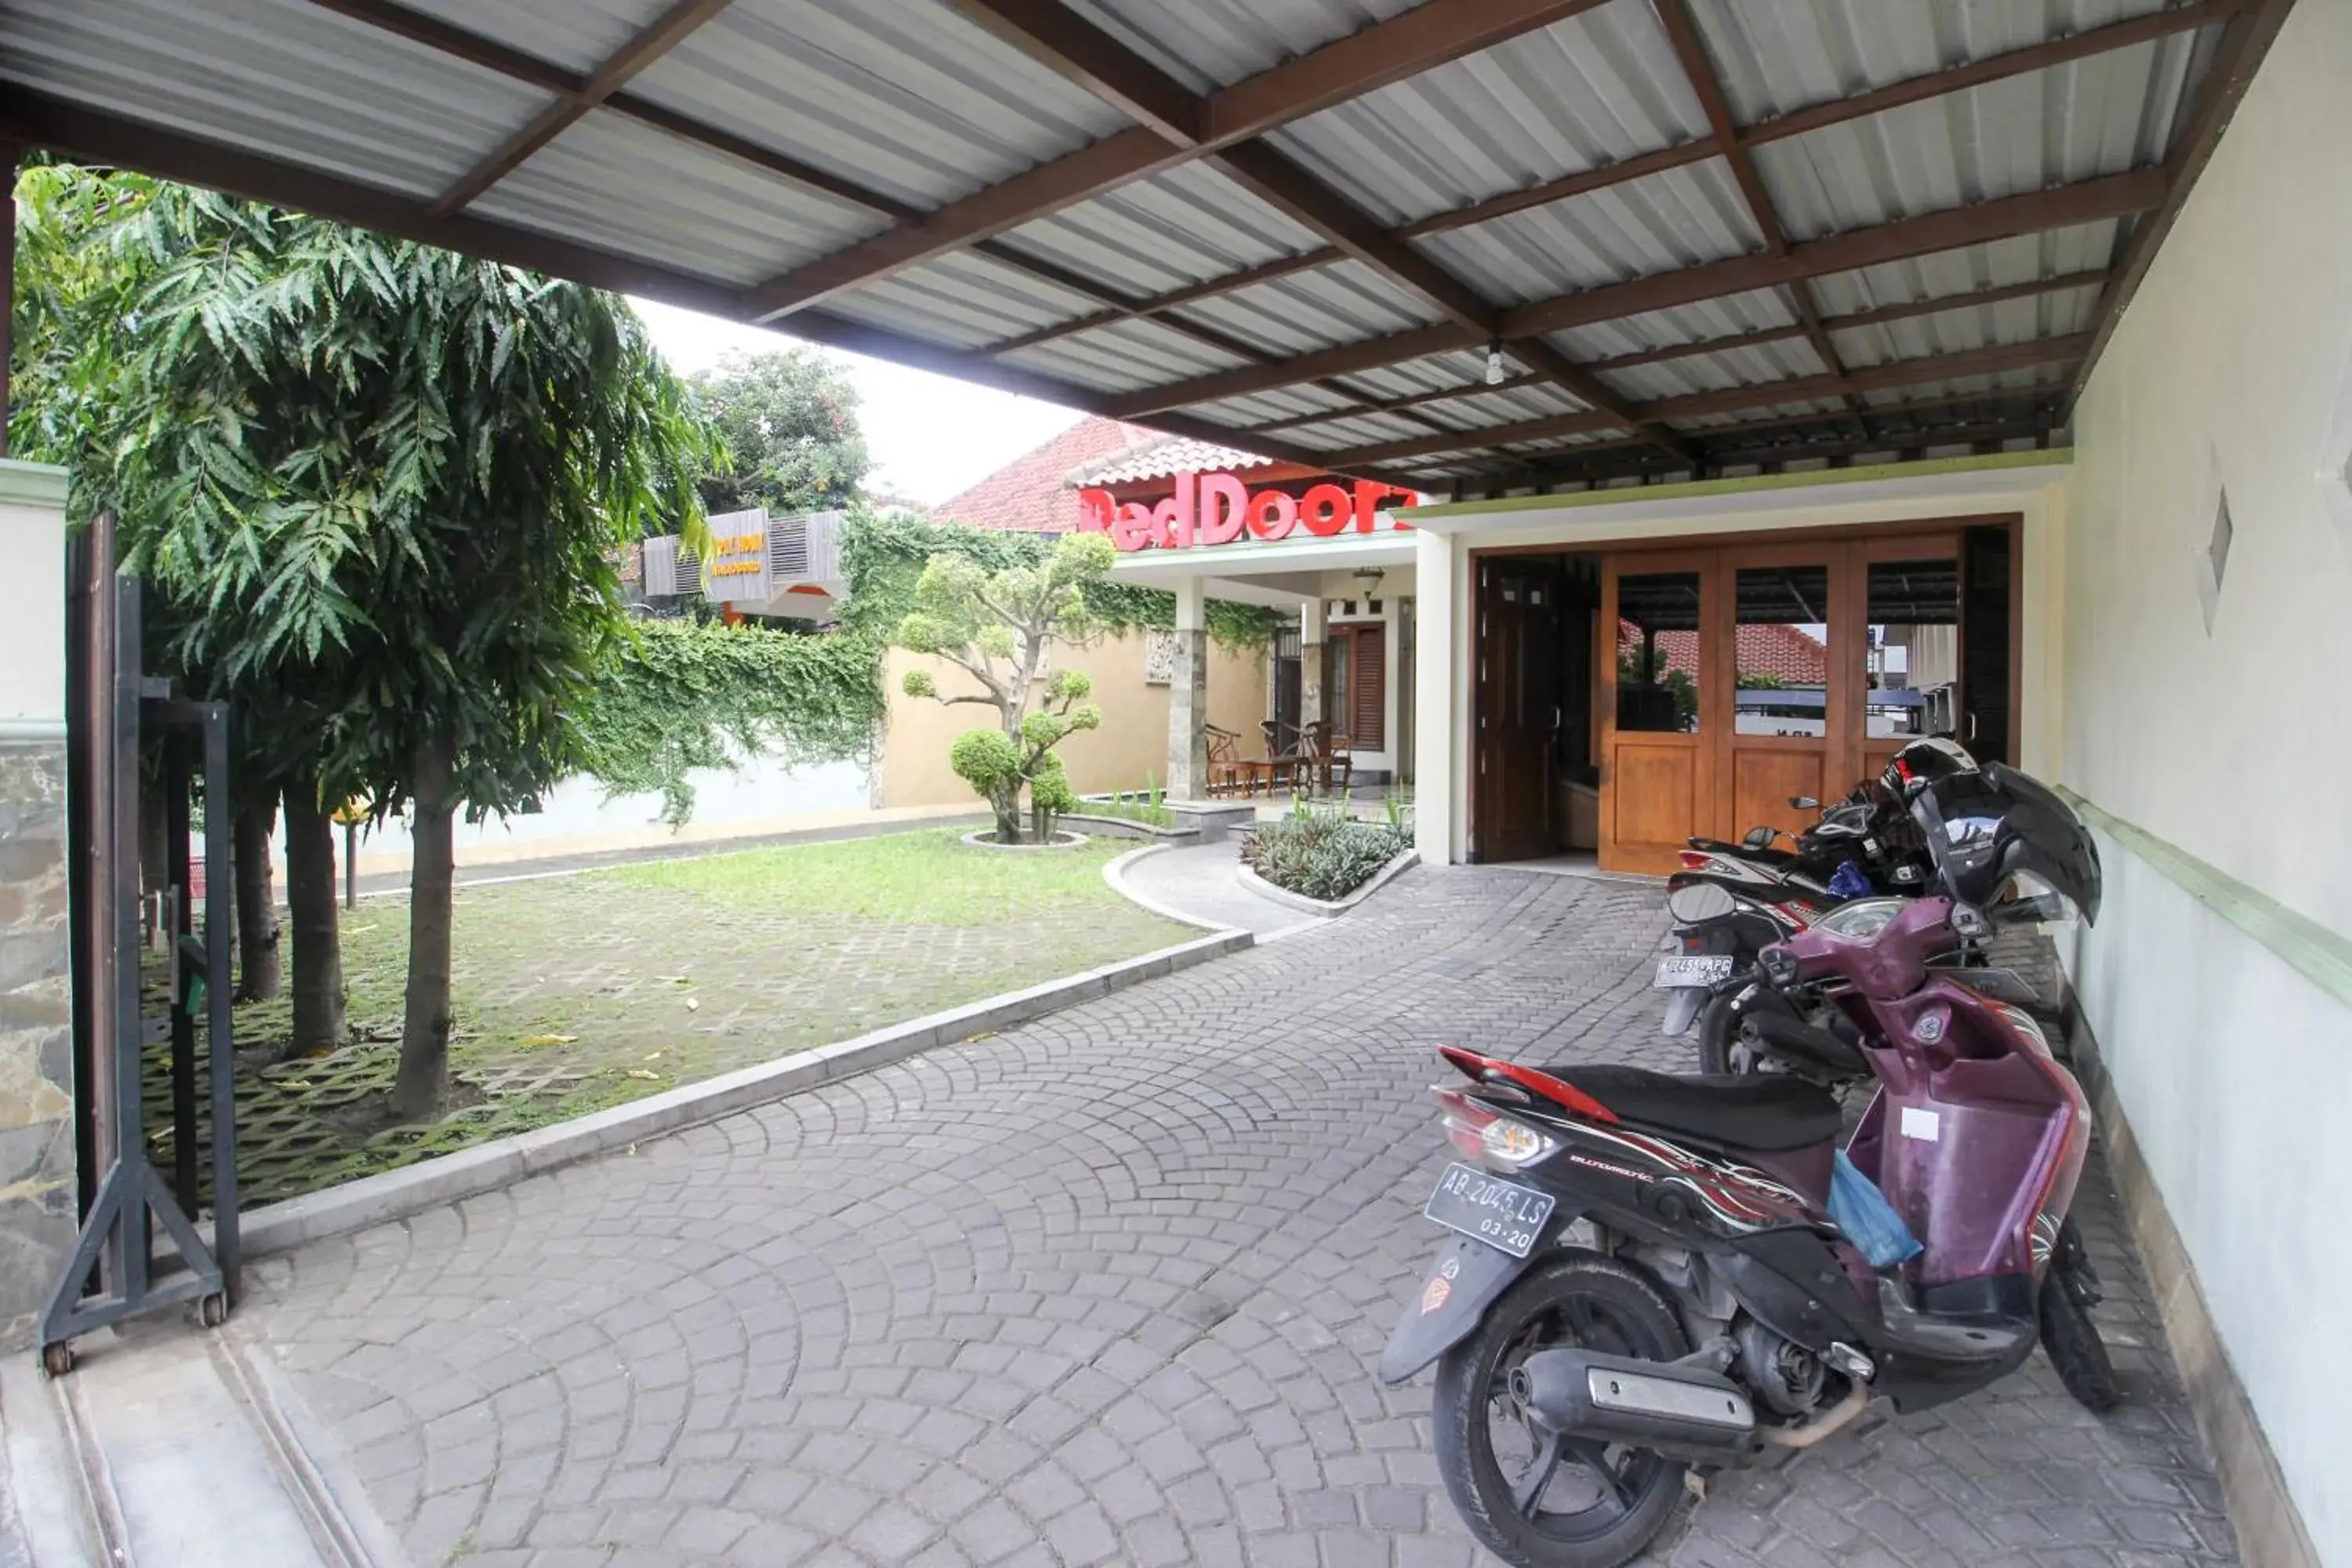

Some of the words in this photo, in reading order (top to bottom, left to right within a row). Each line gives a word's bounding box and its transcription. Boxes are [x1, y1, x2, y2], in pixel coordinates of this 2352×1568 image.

[1443, 1170, 1469, 1196] AB
[1468, 1180, 1518, 1212] 2045
[1517, 1196, 1545, 1224] LS
